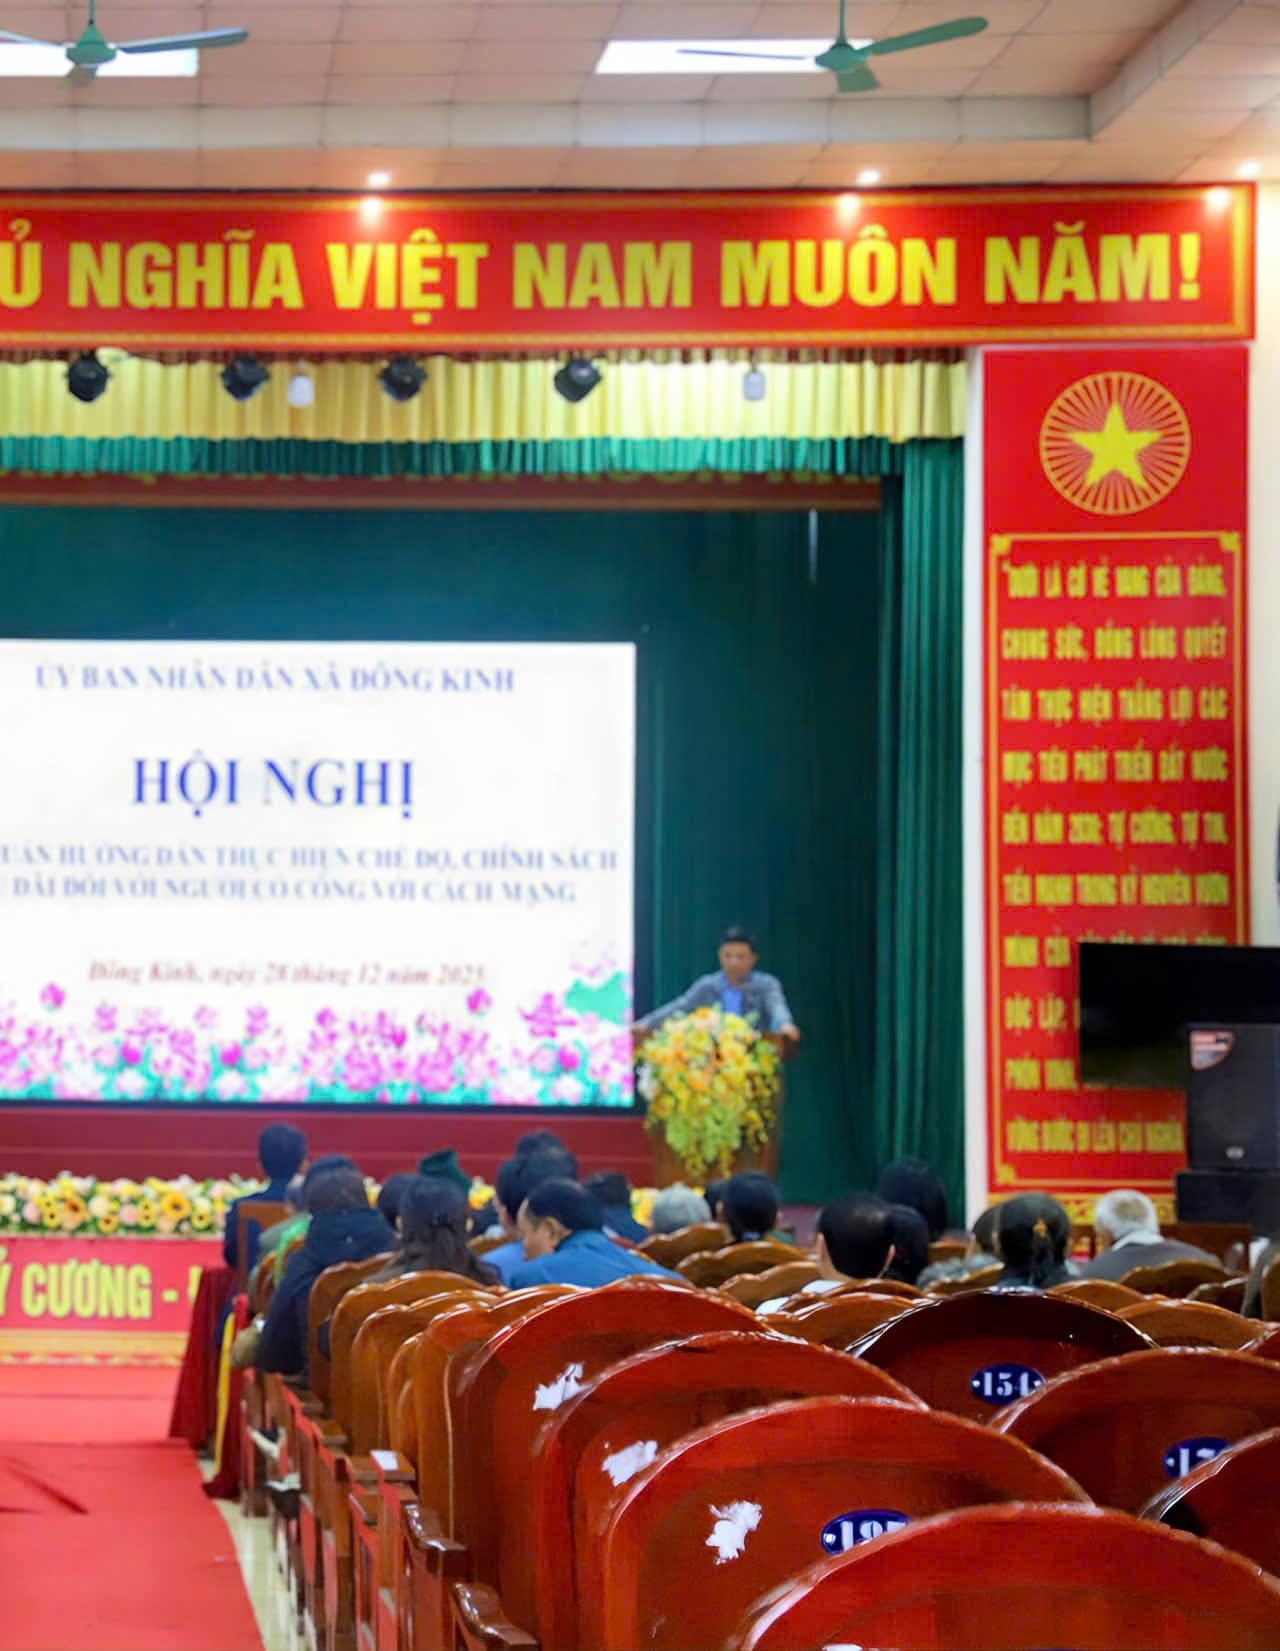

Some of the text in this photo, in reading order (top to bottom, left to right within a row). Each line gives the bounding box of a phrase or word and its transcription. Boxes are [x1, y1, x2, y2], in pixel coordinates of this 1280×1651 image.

[69, 229, 304, 309] NGHĨA
[326, 227, 488, 324] VIỆT
[514, 241, 692, 308] NAM
[722, 224, 956, 308] MUÔN
[984, 221, 1200, 304] NĂM!
[82, 665, 138, 690] BAN
[148, 662, 226, 691] NHÂN
[236, 662, 294, 691] DÂN
[304, 661, 342, 692] XÃ
[351, 661, 433, 693] ĐỒNG
[441, 668, 515, 693] KINH
[133, 749, 414, 819] HỘI NGHỊ
[359, 962, 381, 985] 12
[22, 1259, 152, 1318] CƯƠNG
